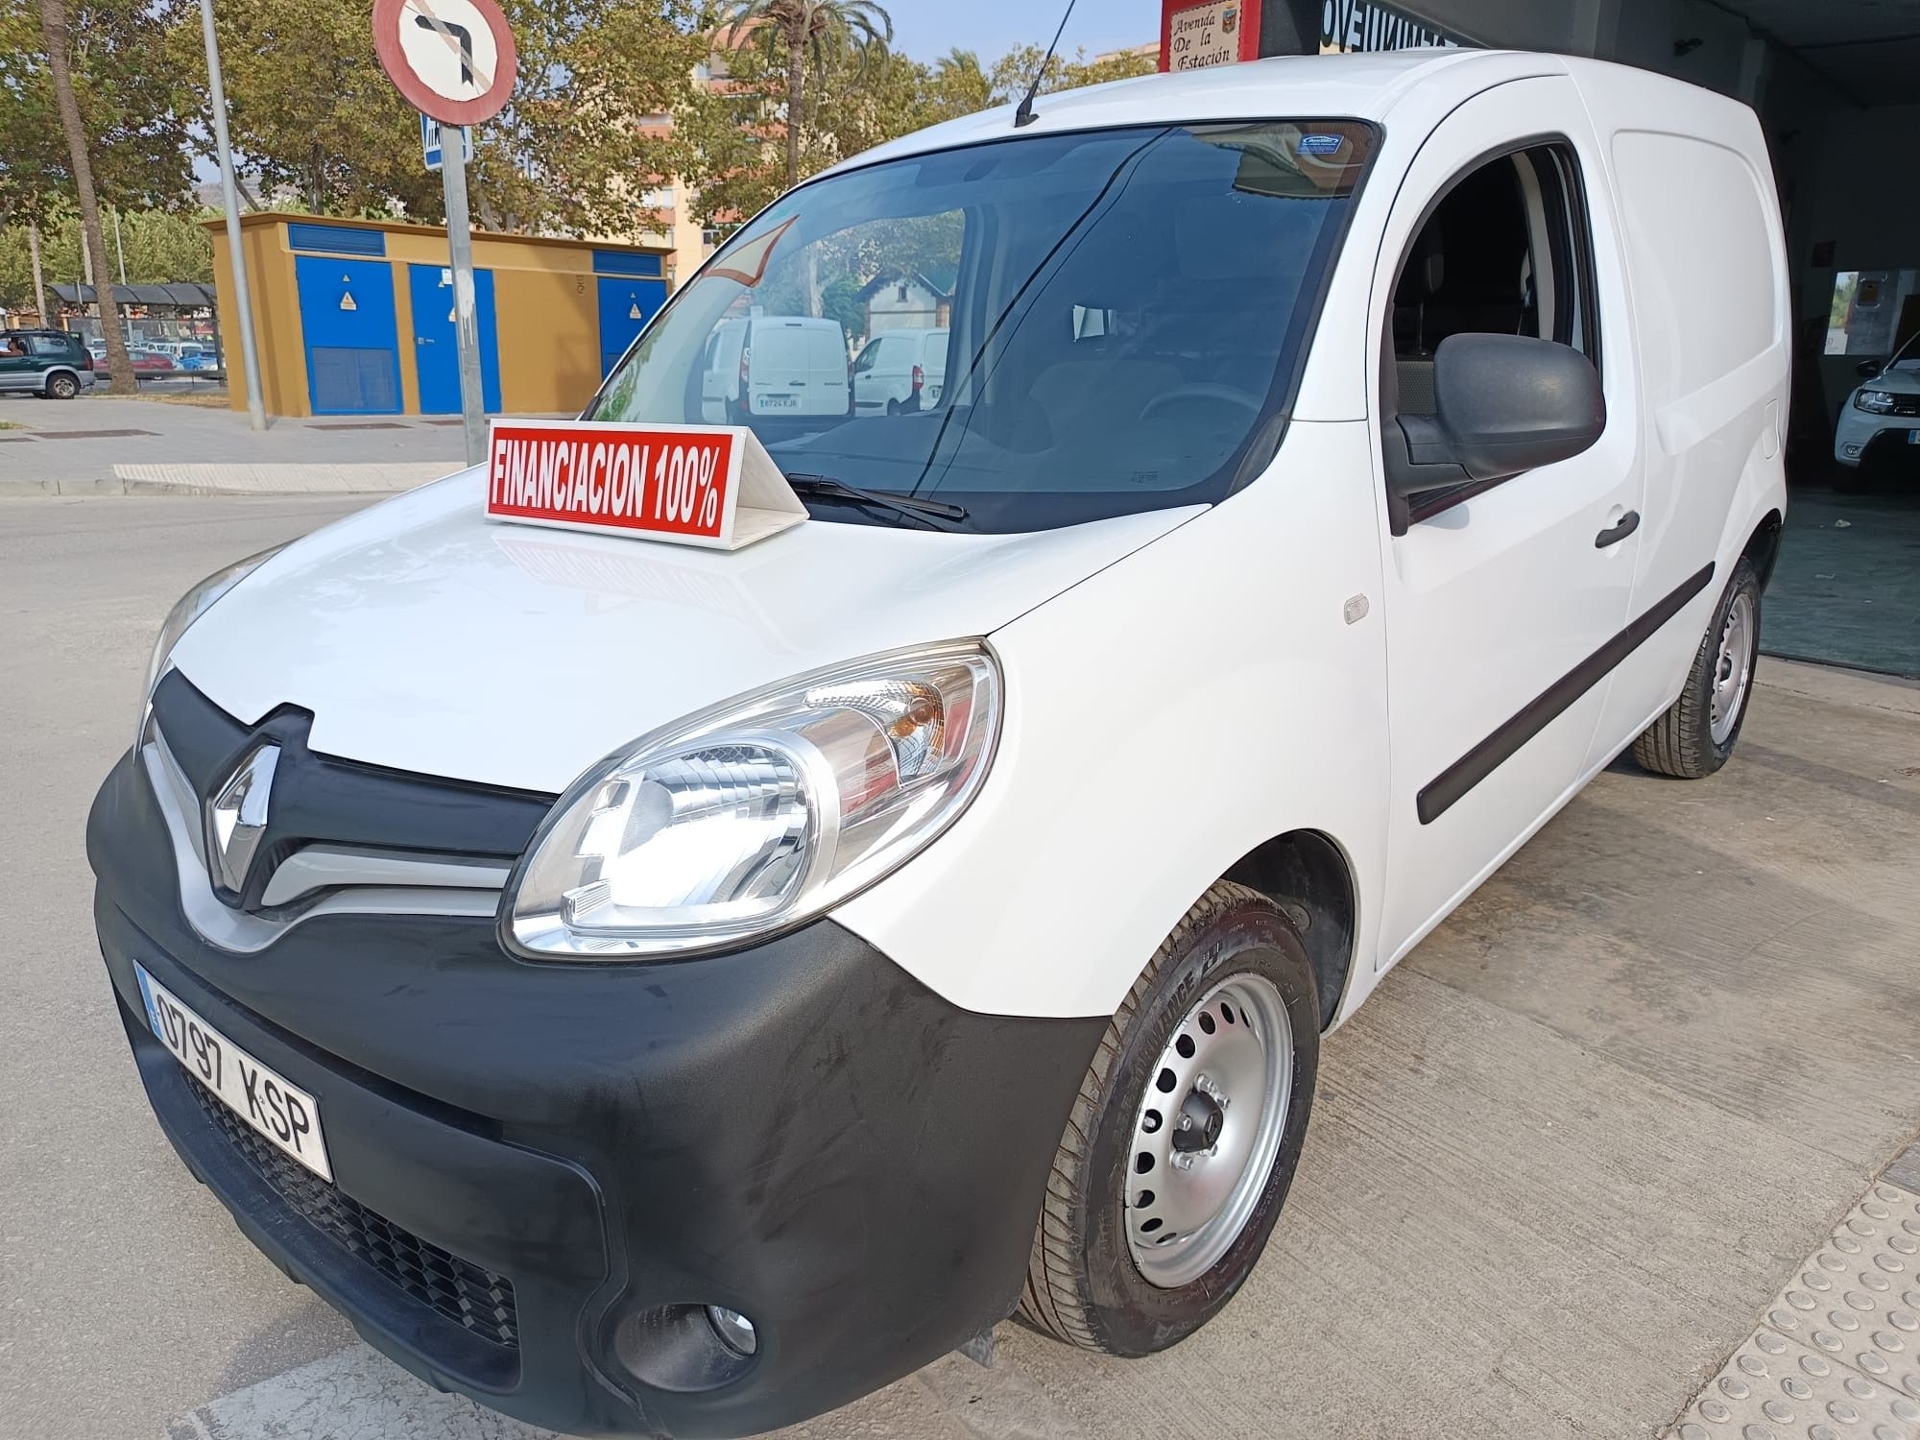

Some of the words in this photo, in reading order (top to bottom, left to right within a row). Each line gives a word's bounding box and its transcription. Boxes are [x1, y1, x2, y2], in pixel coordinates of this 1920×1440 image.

[1174, 10, 1215, 36] Avenida
[1173, 37, 1191, 53] De
[1200, 27, 1211, 46] la
[1178, 46, 1230, 70] Estación
[492, 439, 649, 518] FINANCIACION
[654, 446, 720, 528] 100%
[157, 994, 222, 1091] 0797
[239, 1059, 309, 1153] KSP
